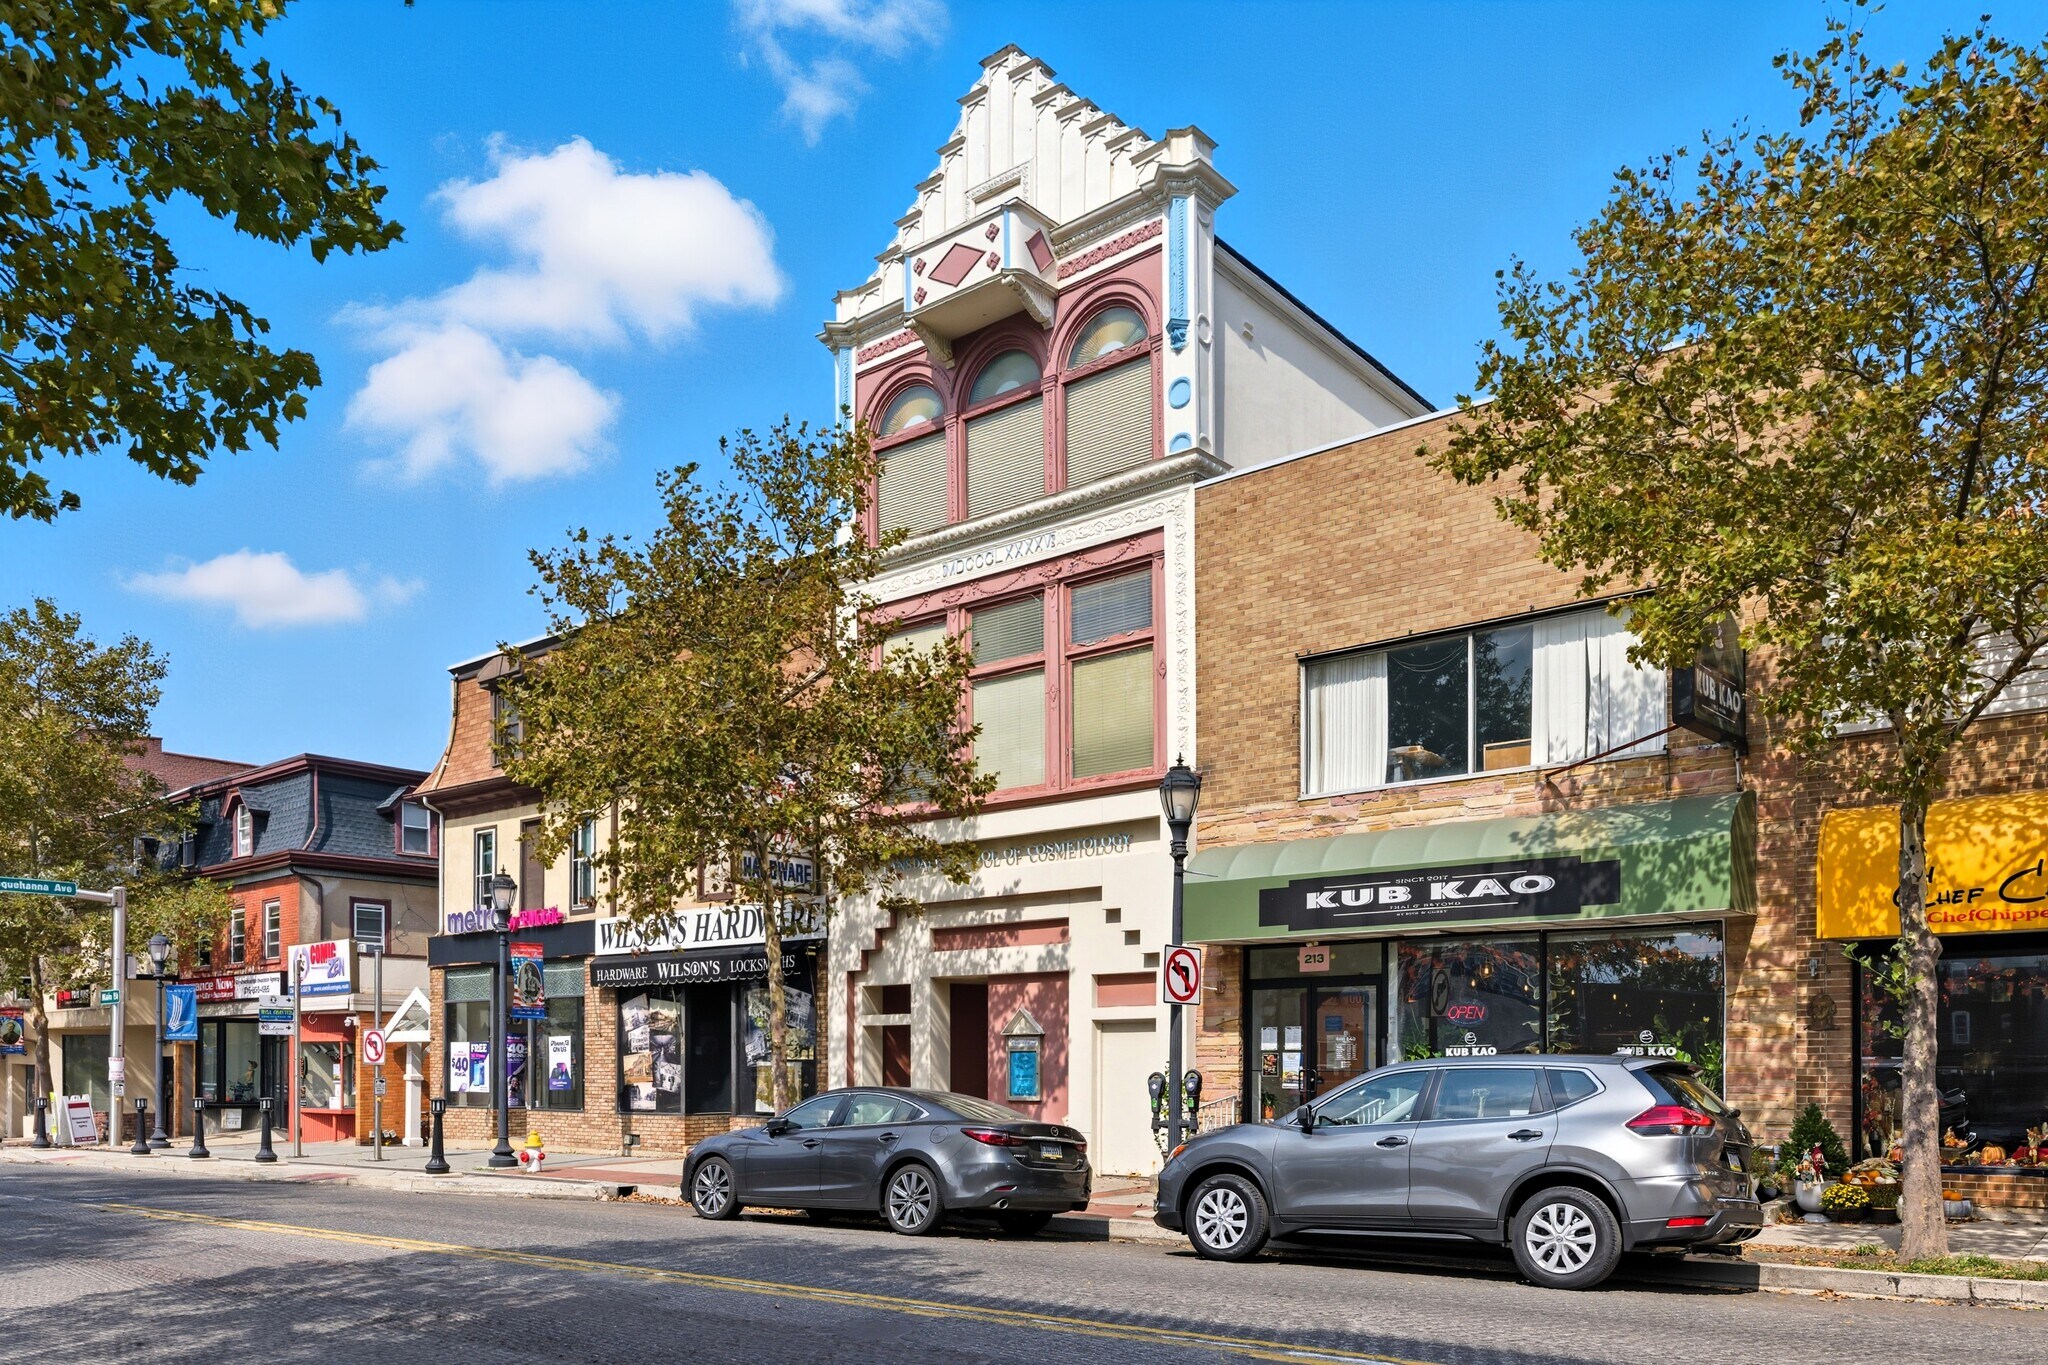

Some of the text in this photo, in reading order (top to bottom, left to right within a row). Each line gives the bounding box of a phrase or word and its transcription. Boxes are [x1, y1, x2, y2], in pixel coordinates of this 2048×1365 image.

[1696, 668, 1741, 713] KUB KAO
[1027, 834, 1132, 857] COSMETOLOGY
[743, 856, 812, 884] HADWARE
[1, 881, 72, 893] quehanna Ave
[1395, 876, 1425, 884] SINCE
[1999, 859, 2048, 904] C
[1306, 875, 1556, 910] KUB KAO
[1927, 908, 2048, 925] ChefChippe
[600, 902, 820, 950] WILSONS HARDRE
[310, 942, 336, 965] COMIC
[1304, 953, 1325, 964] 213
[596, 955, 795, 982] HARDWARE WILSON'S LOCKSHS
[216, 978, 234, 990] Now
[1447, 1005, 1486, 1019] OPEN
[471, 1043, 488, 1053] FREE
[1445, 1046, 1497, 1057] KUB KAO
[1647, 1046, 1677, 1056] KAO
[452, 1056, 469, 1072] $40
